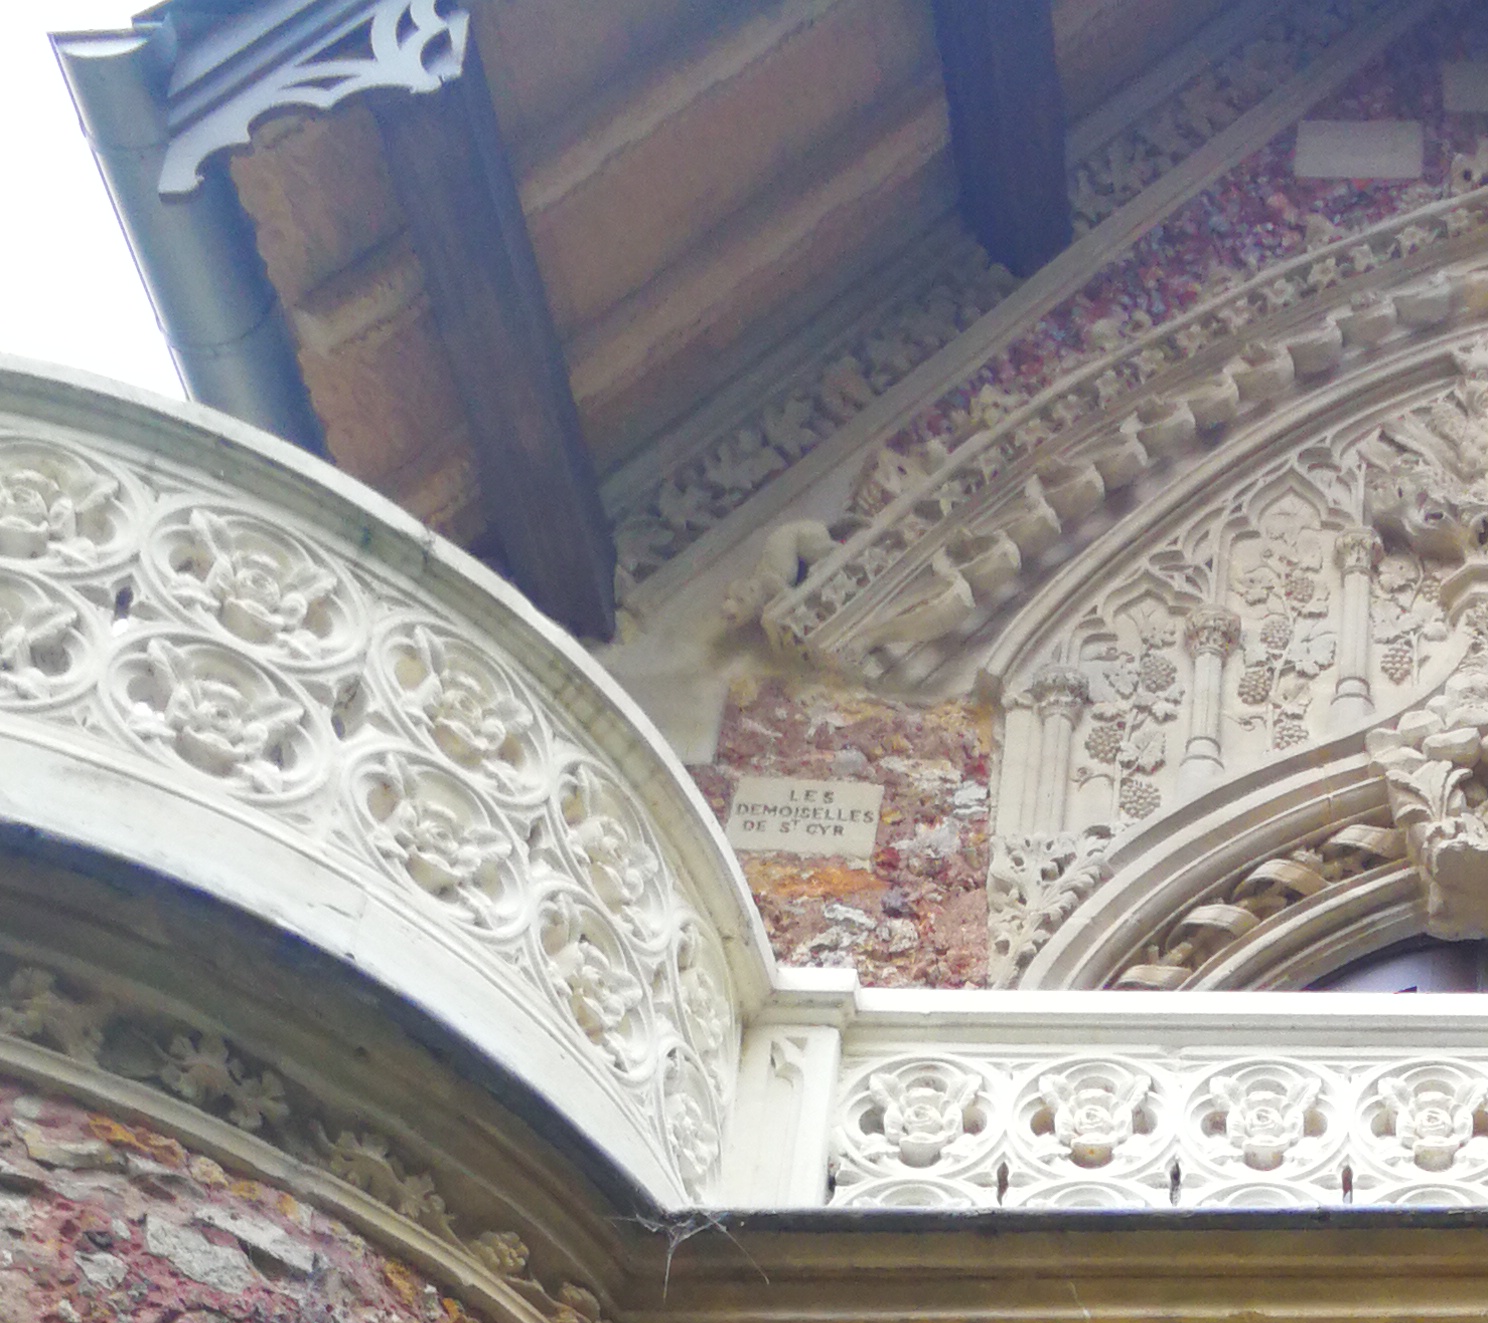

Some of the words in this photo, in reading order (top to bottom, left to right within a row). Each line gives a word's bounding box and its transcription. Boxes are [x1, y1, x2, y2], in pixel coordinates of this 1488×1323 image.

[790, 789, 835, 805] LES
[732, 803, 875, 824] DEMOISELLES
[742, 820, 767, 833] DE
[806, 823, 845, 837] CYR
